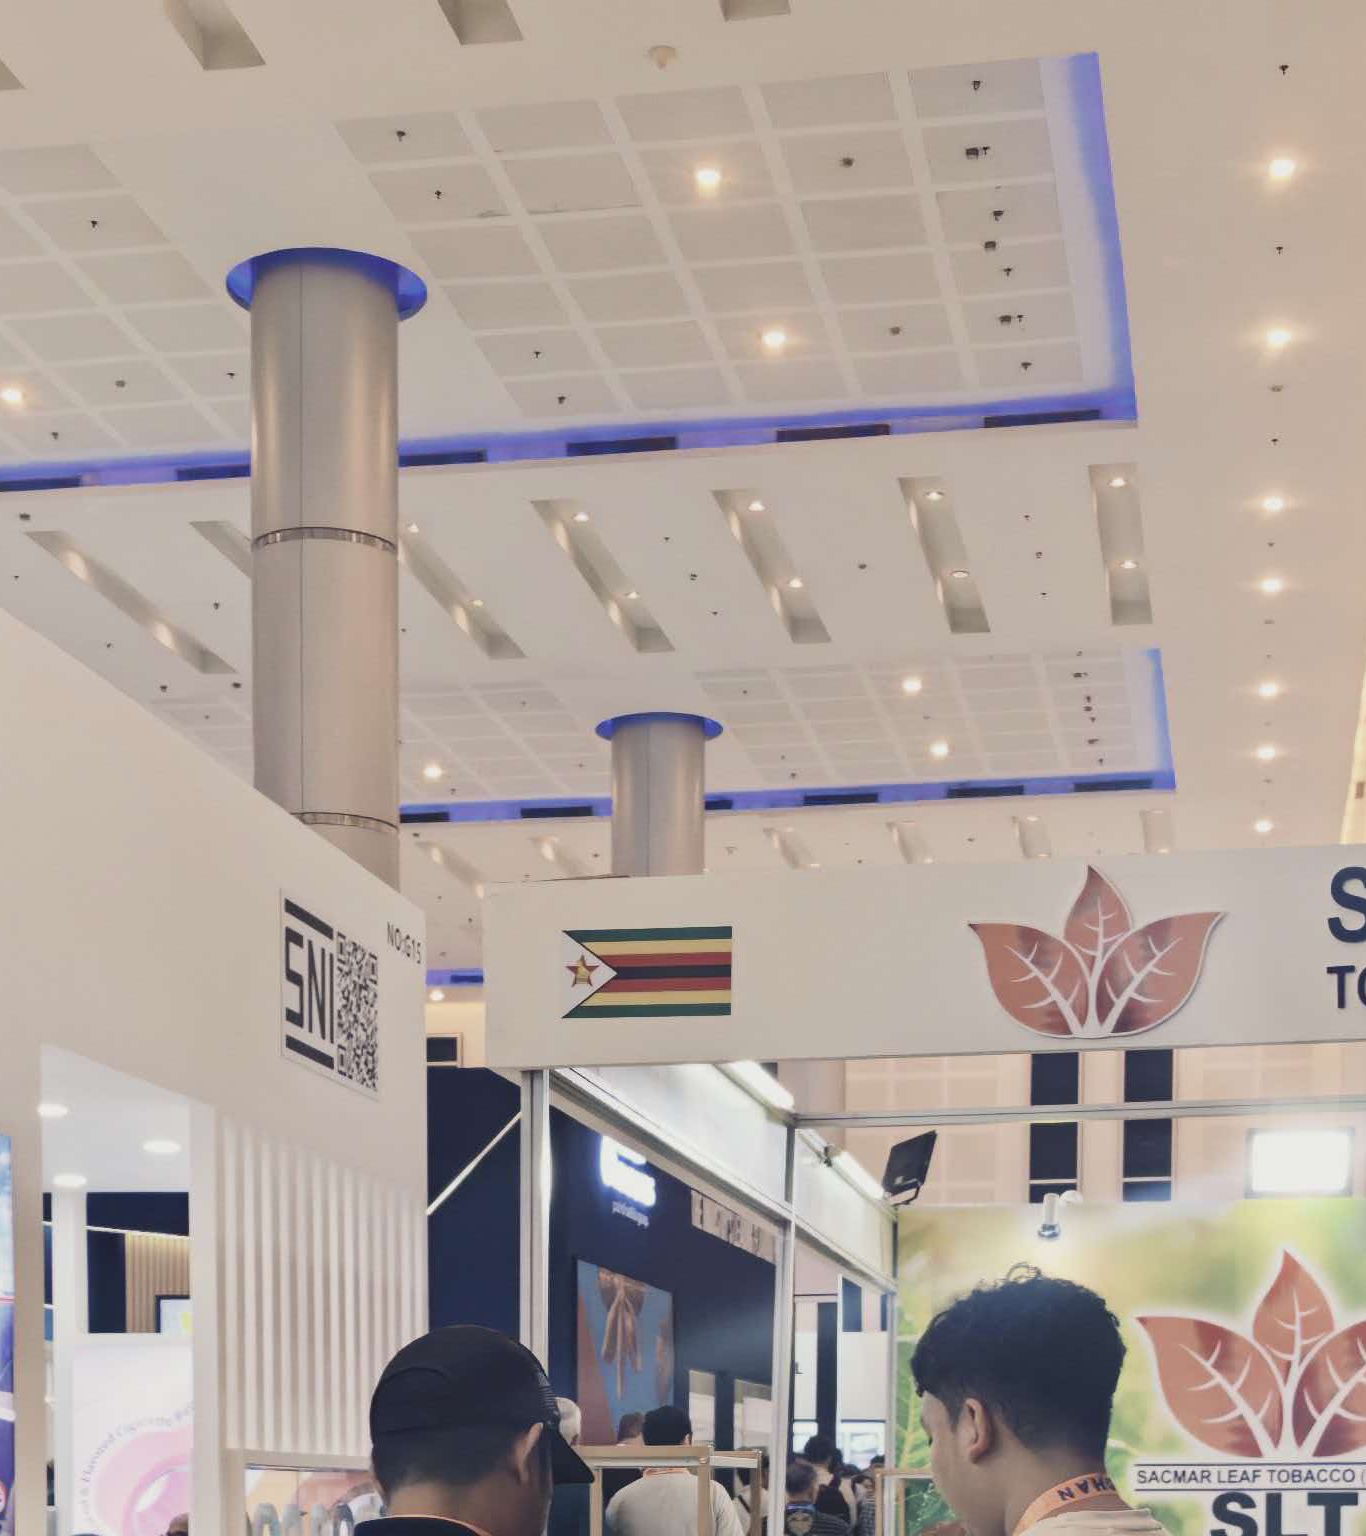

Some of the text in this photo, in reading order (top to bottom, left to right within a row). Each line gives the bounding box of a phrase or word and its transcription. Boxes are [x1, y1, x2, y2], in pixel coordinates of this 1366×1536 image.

[285, 926, 334, 1044] SNI
[1137, 1469, 1212, 1485] SACMAR
[1217, 1468, 1262, 1484] LEAF
[1267, 1467, 1355, 1484] TOBACCO
